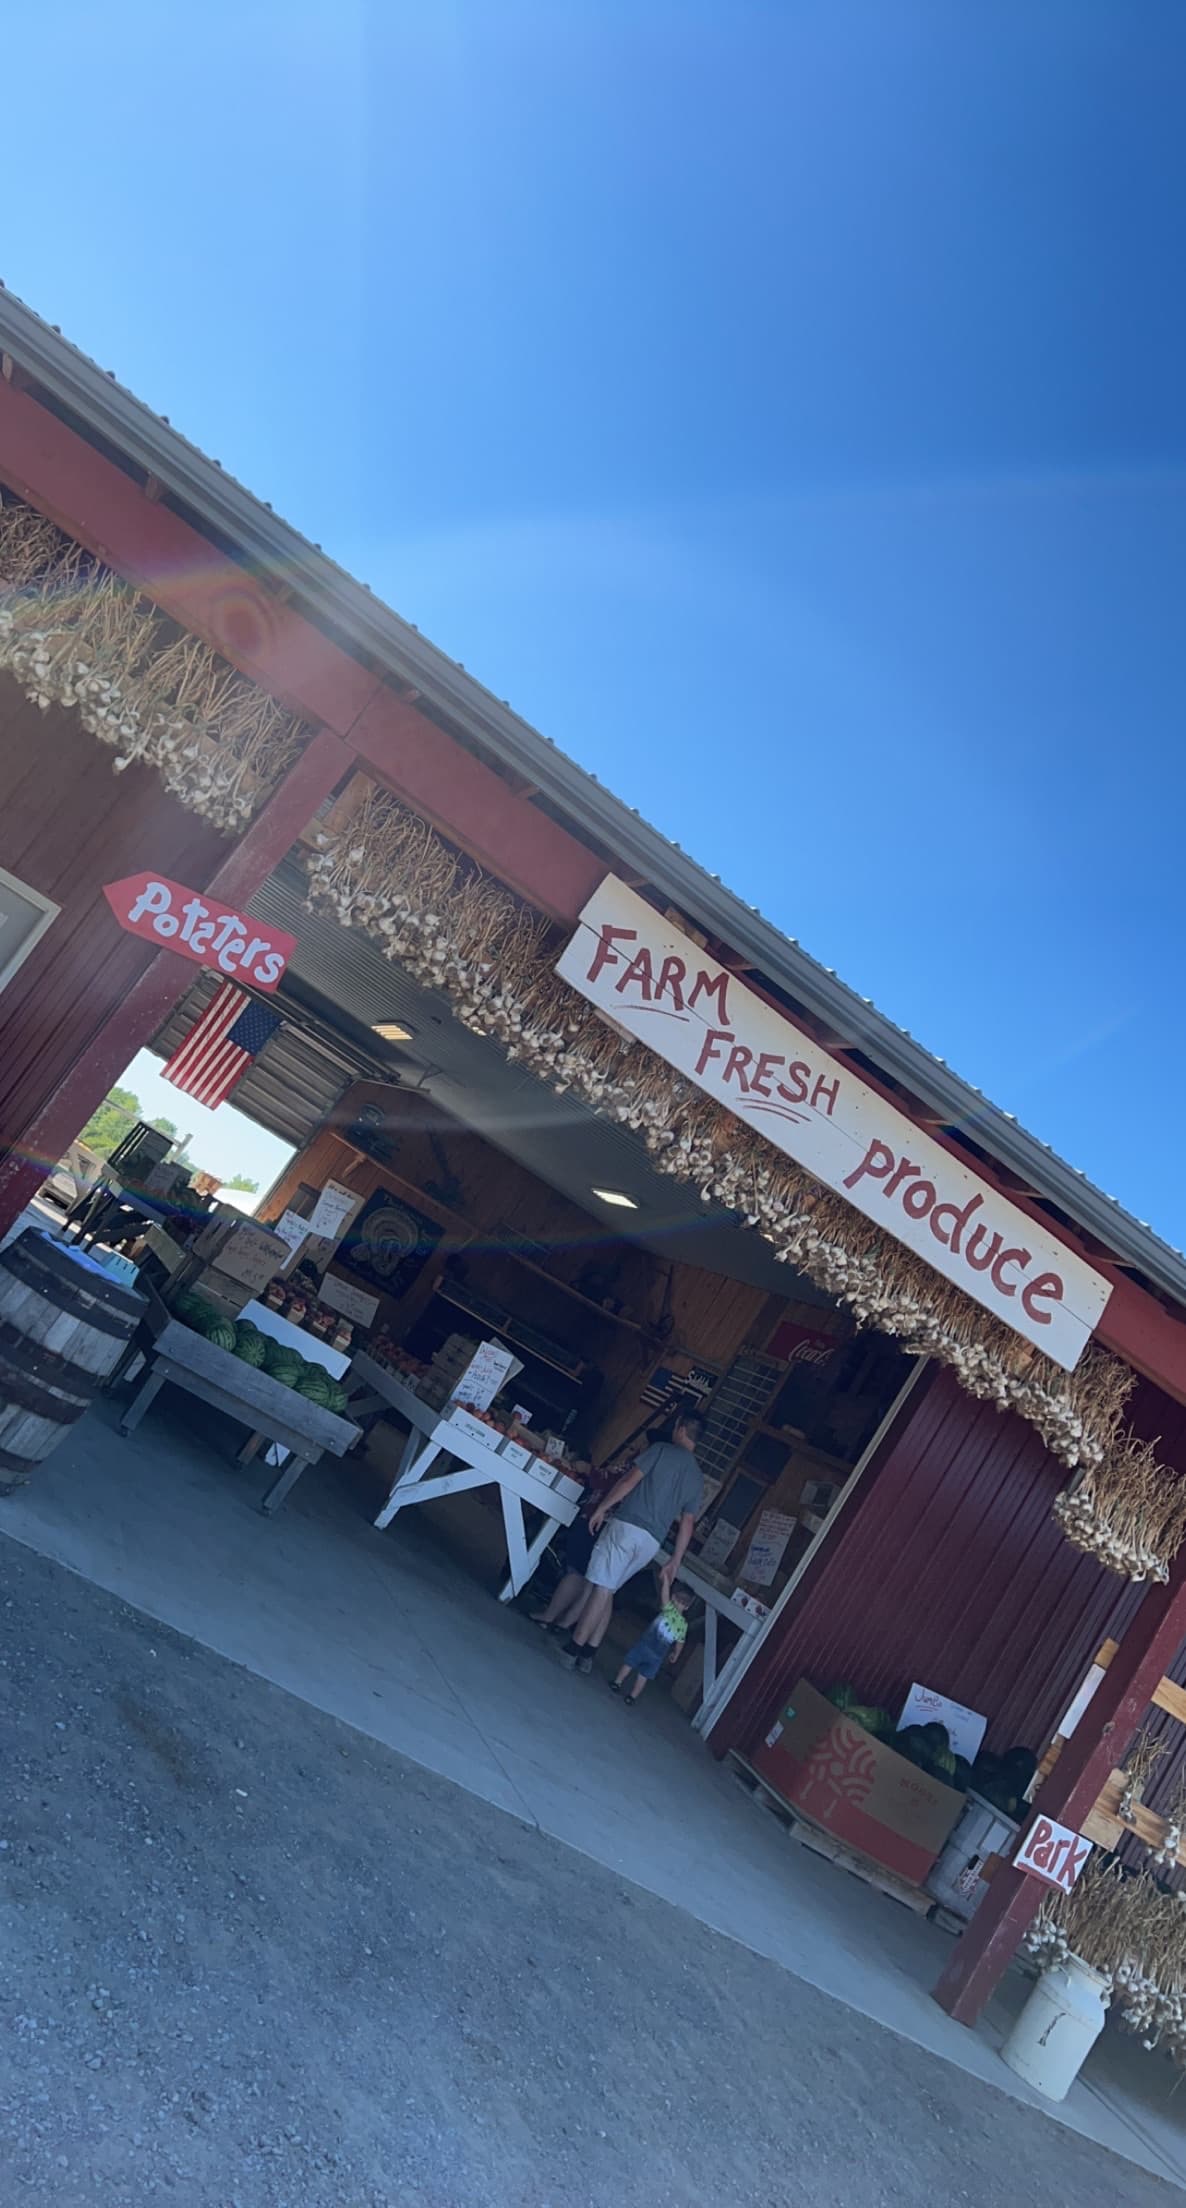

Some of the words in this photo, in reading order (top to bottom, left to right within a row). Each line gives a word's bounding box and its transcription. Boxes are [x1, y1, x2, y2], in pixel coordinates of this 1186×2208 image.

[586, 924, 731, 1026] FARM
[694, 1028, 841, 1116] FRESH
[842, 1138, 1064, 1325] produce
[1024, 1819, 1088, 1888] Park
